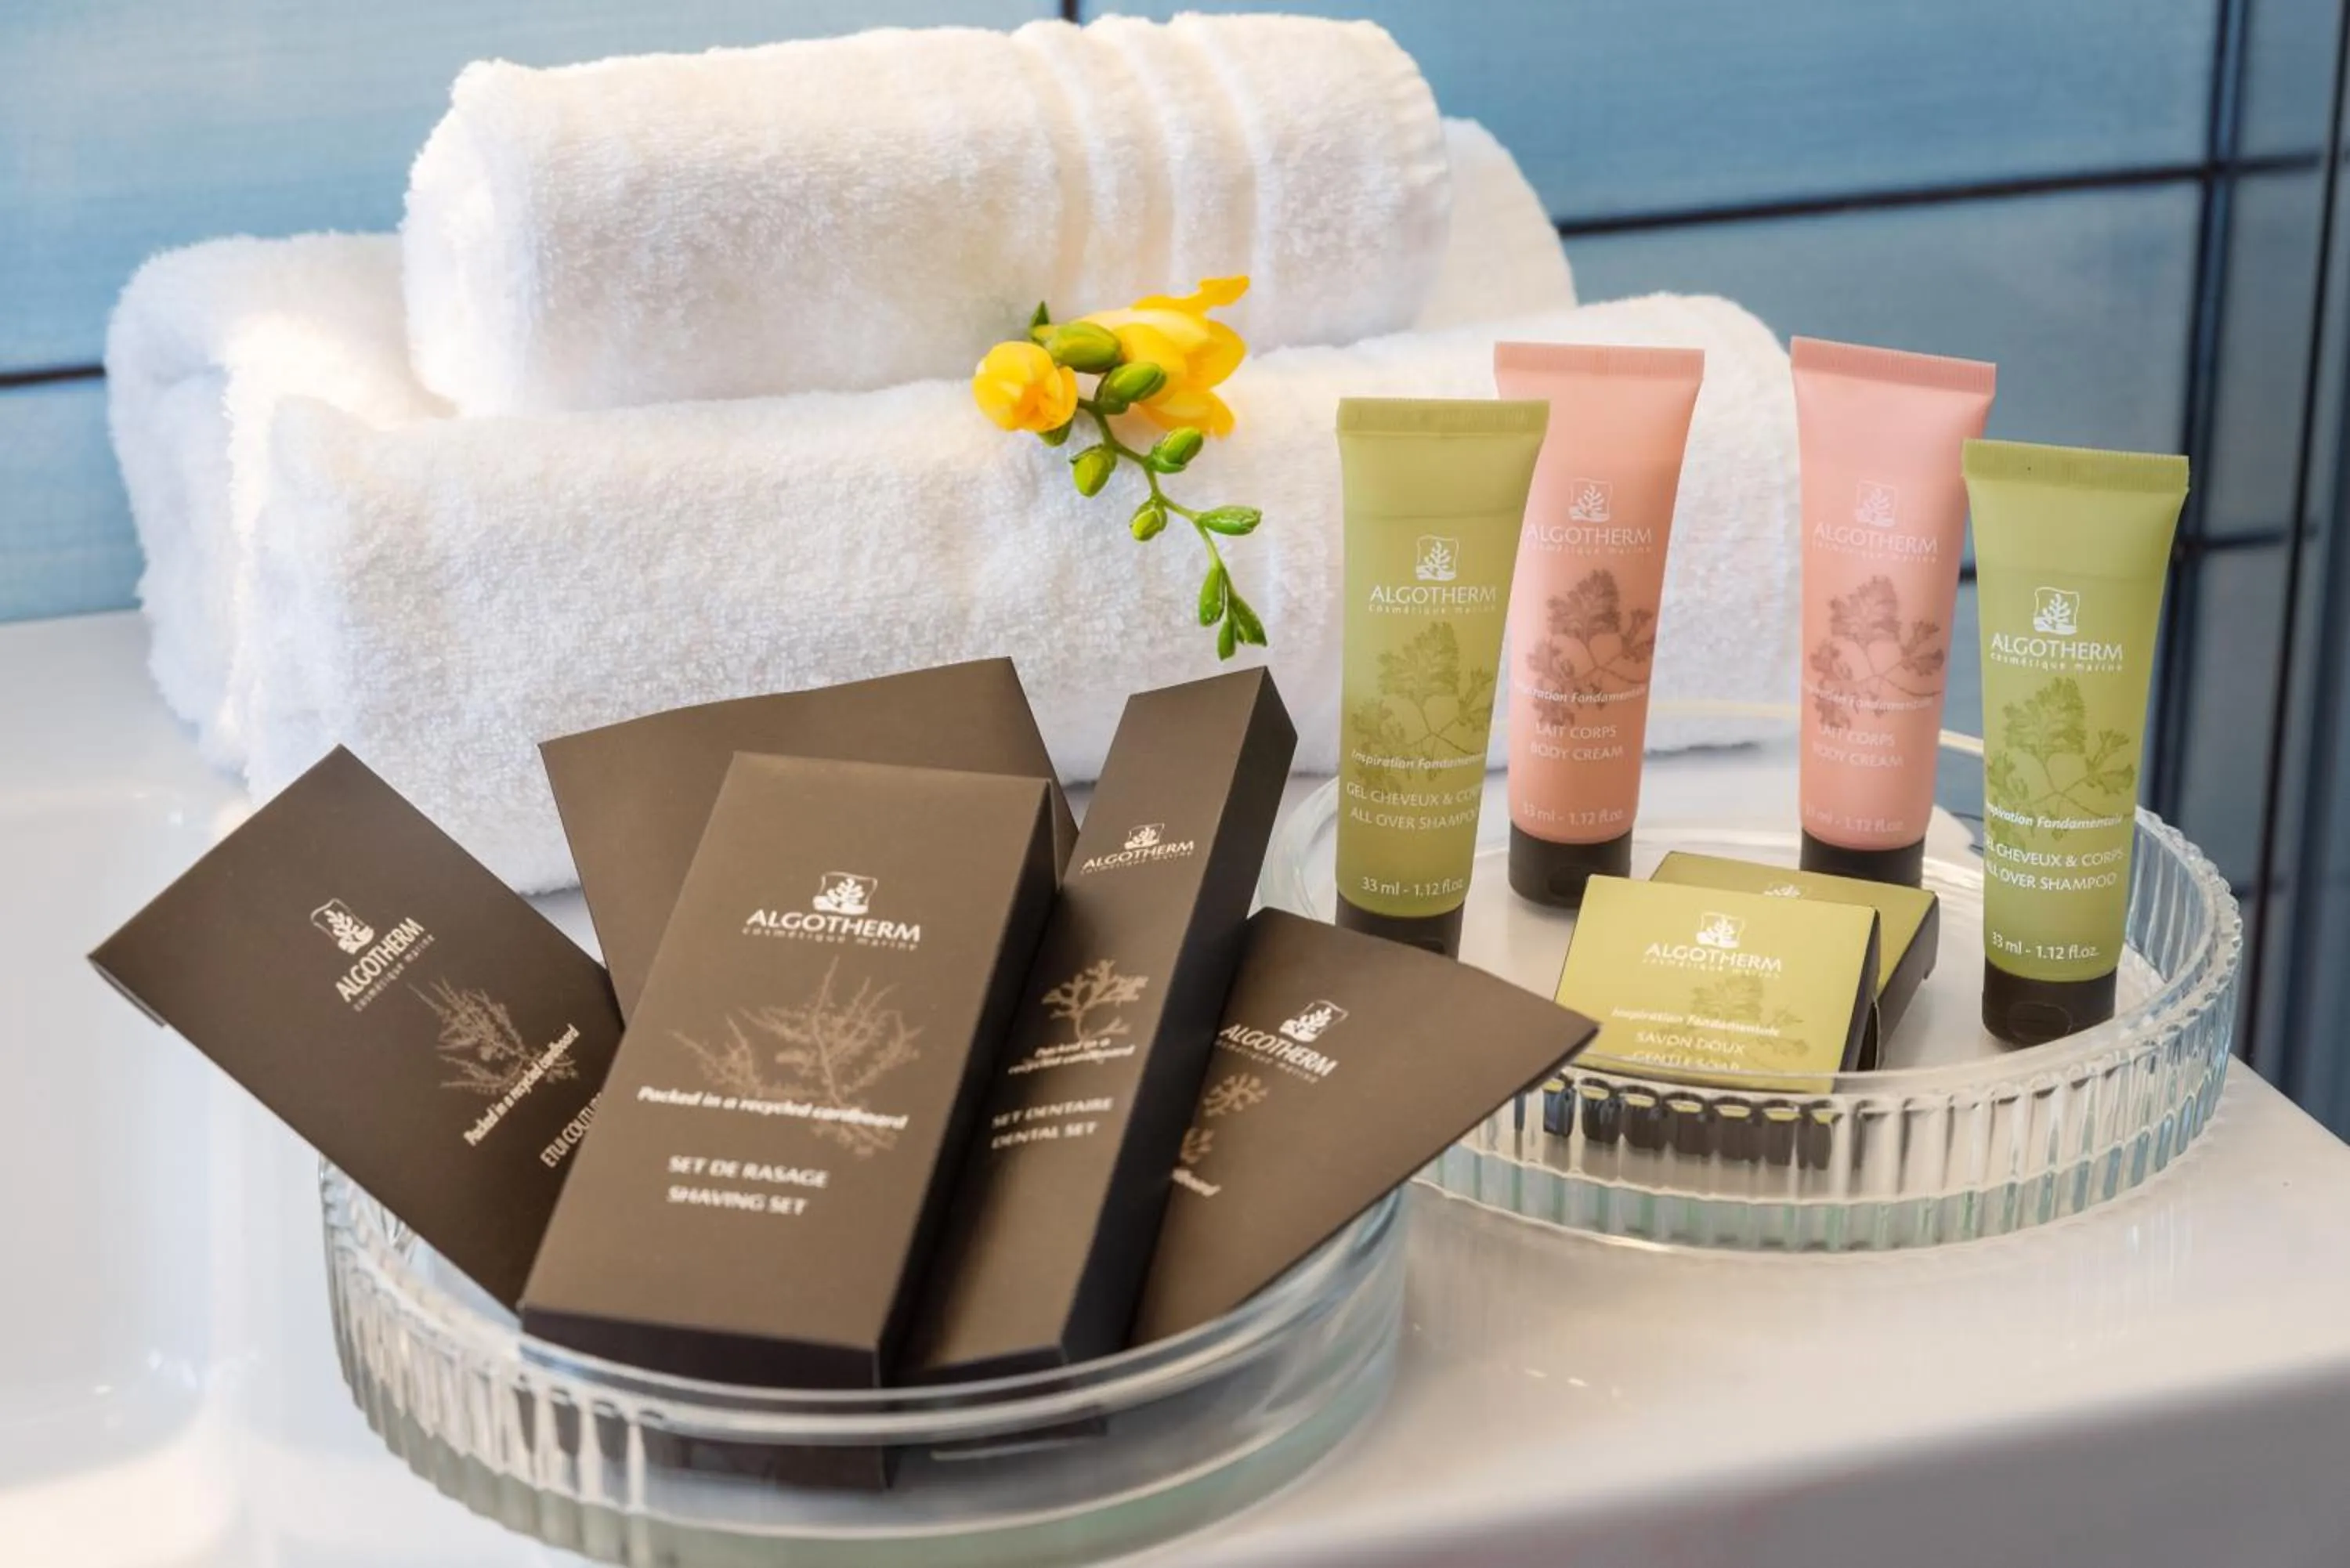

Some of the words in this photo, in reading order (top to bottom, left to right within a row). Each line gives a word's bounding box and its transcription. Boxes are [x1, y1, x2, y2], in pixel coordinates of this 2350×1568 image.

[1524, 522, 1653, 546] ALGOTHERM
[1811, 521, 1939, 555] ALGOTHERM
[1370, 584, 1496, 605] ALGOTHERM
[1990, 631, 2124, 663] ALGOTHERM
[1569, 724, 1618, 740] CORPS
[1350, 749, 1414, 769] Inspiration
[1530, 741, 1567, 760] BODY
[1572, 745, 1625, 761] CREAM
[1347, 782, 1368, 800] GEL
[1370, 789, 1440, 807] CHEVEUX
[1442, 793, 1454, 805] &
[1350, 806, 1373, 824] ALL
[1376, 813, 1416, 829] OVER
[1418, 807, 1479, 830] SHAMPO
[1537, 808, 1555, 822] ml
[1082, 840, 1195, 871] ALGOTHERM
[1996, 843, 2063, 868] CHEVEUX
[2065, 854, 2078, 868] &
[2081, 847, 2124, 868] CORPS
[1361, 876, 1379, 892] 33
[1380, 881, 1401, 896] ml
[1414, 882, 1440, 898] 1.12
[2000, 867, 2037, 889] OVER
[2039, 871, 2117, 892] SHAMPOO
[746, 909, 921, 943] ALGOTHERM
[334, 916, 425, 1003] ALGOTHERM
[1643, 942, 1783, 973] ALGOTHERM
[2005, 940, 2023, 956] ml
[2035, 945, 2065, 960] 1.12
[1219, 1023, 1339, 1078] ALGOTHERM
[1636, 1031, 1692, 1049] SAVON
[1694, 1036, 1746, 1057] DOUX
[540, 1137, 571, 1169] ETUI
[667, 1154, 708, 1175] SET
[709, 1158, 740, 1179] DE
[741, 1162, 831, 1190] RASAGE
[666, 1184, 768, 1213] SHAVING
[768, 1194, 809, 1216] SET
